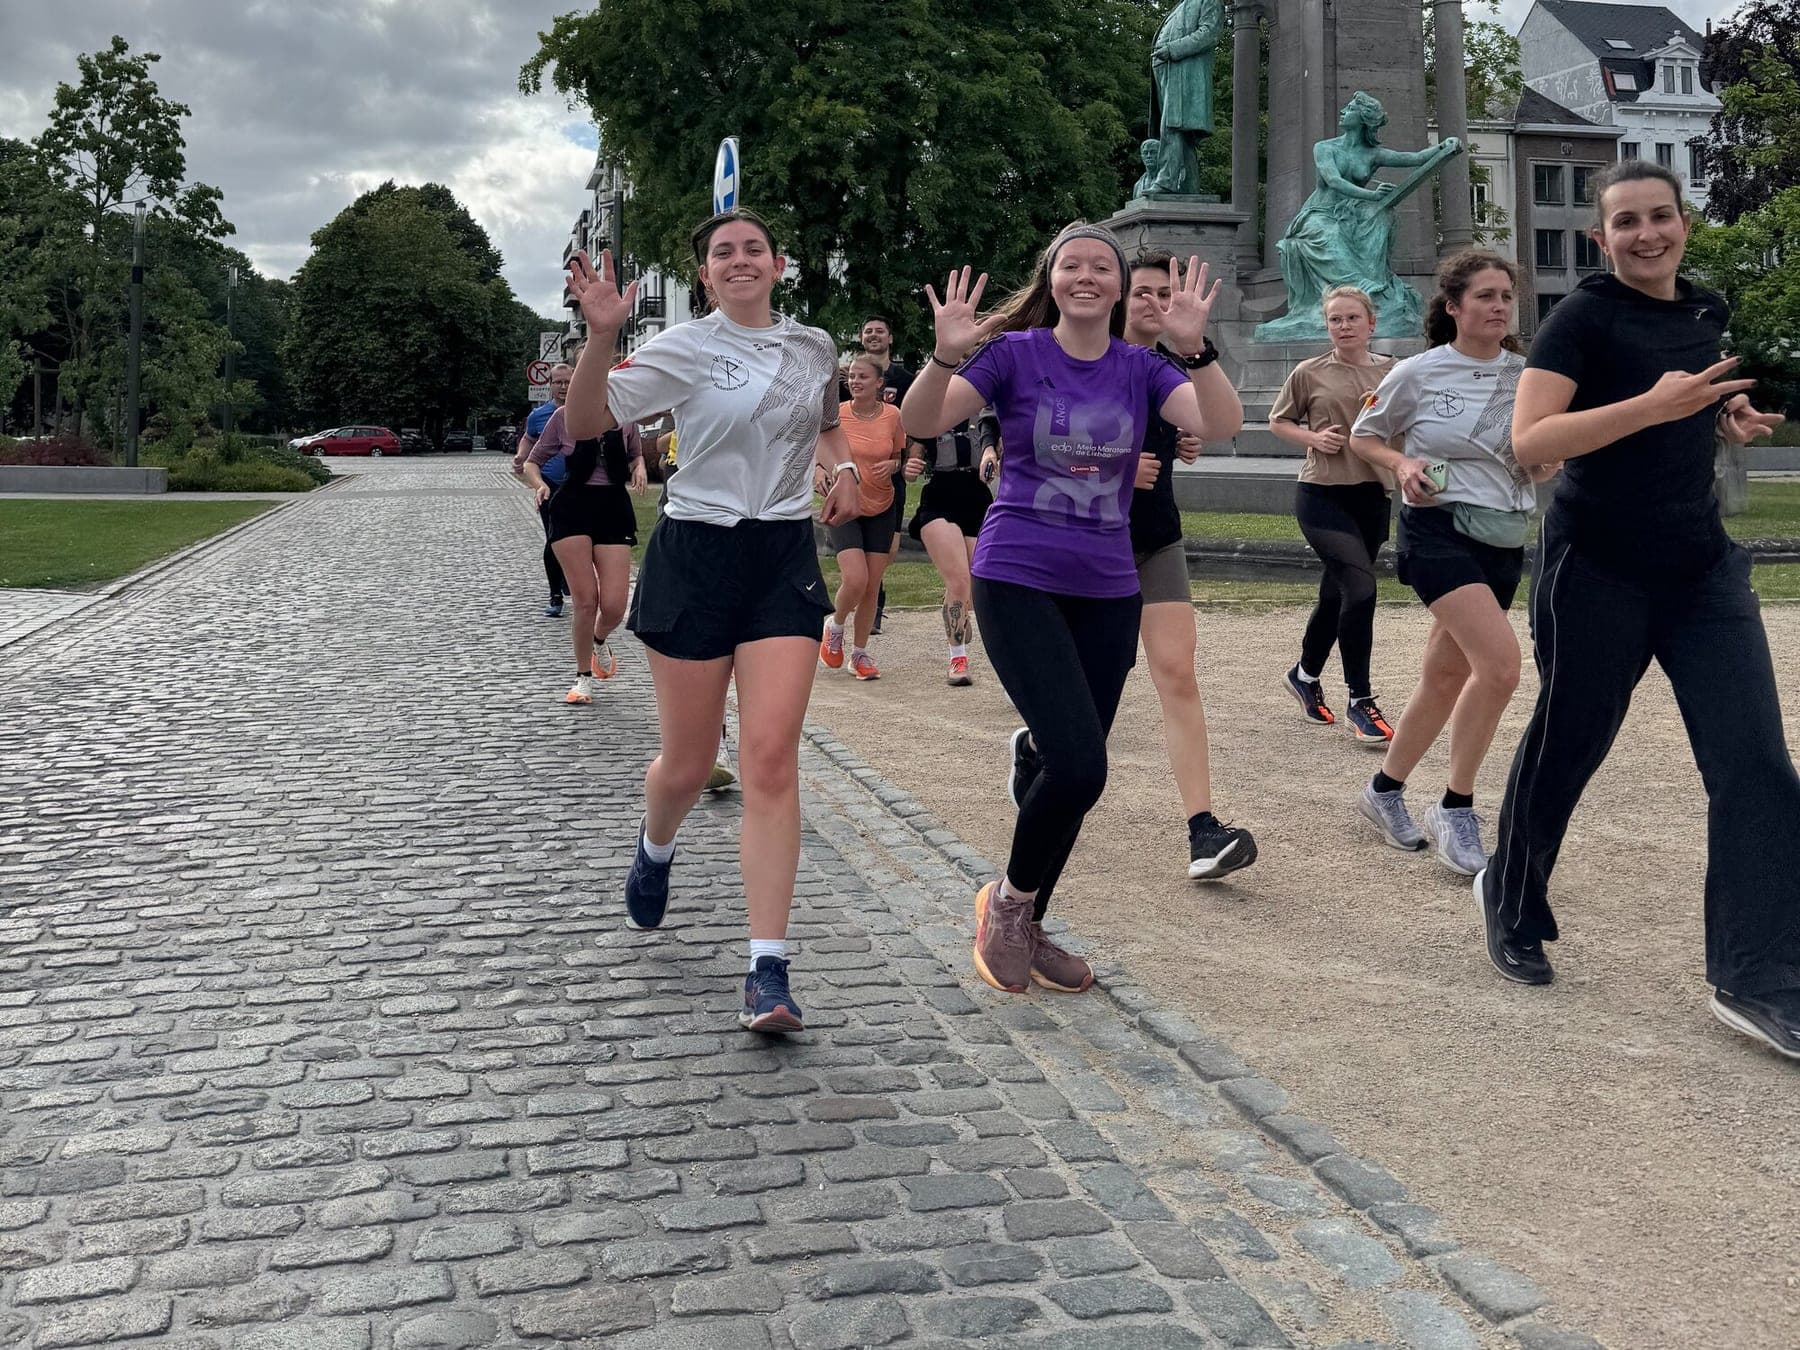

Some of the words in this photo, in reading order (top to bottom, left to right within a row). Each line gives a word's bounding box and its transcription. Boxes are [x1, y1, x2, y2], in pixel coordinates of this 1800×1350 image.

[1055, 396, 1066, 427] ANOS
[1051, 441, 1073, 454] edp
[1098, 445, 1132, 454] Maratona
